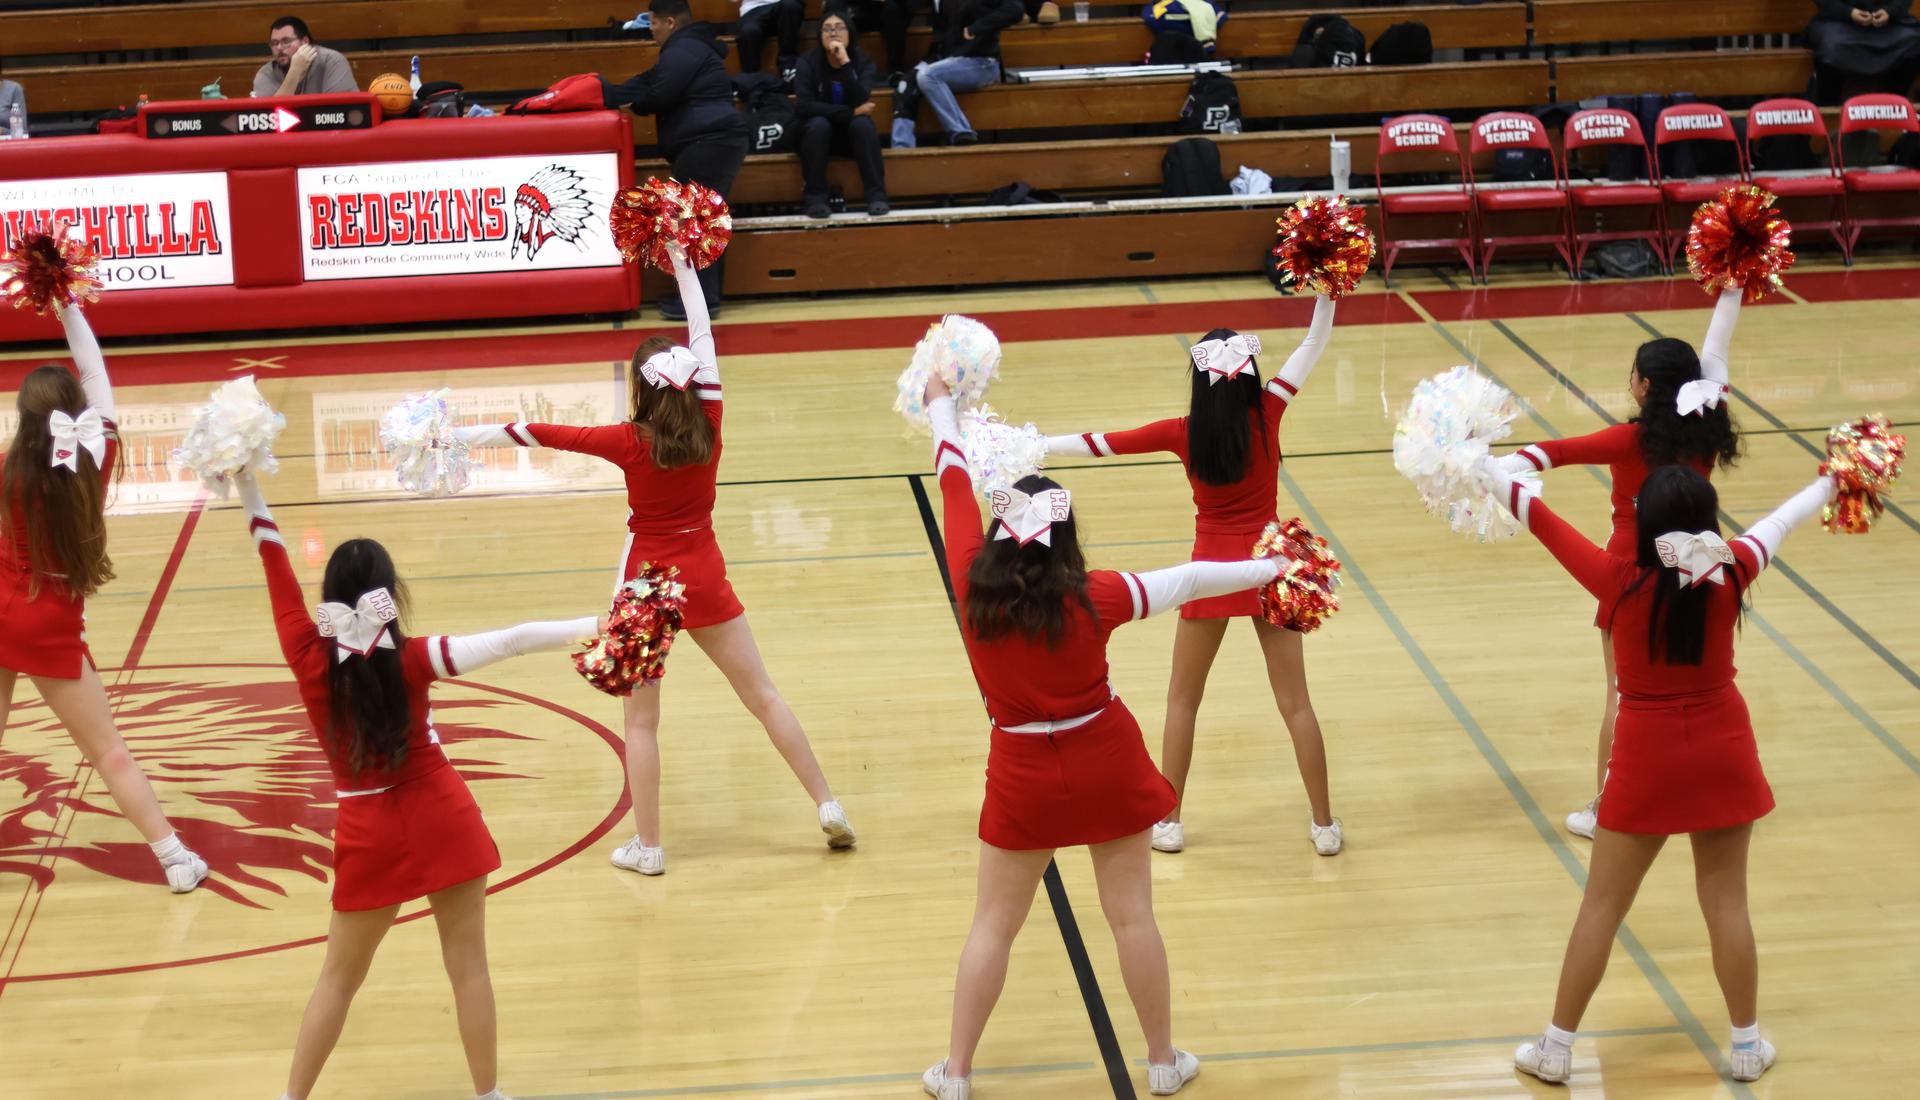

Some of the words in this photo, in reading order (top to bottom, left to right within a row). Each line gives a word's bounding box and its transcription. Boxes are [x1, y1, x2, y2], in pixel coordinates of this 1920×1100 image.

[1203, 104, 1230, 130] P
[1755, 109, 1815, 126] CHOWCHILLA
[1847, 104, 1908, 121] CHOWCHILLA
[172, 119, 202, 132] BONUS
[238, 112, 278, 131] POSS
[315, 113, 345, 125] BONUS
[1388, 121, 1446, 139] OFFICIAL
[1478, 118, 1536, 137] OFFICIAL
[1573, 114, 1631, 133] OFFICIAL
[1664, 114, 1724, 131] CHOWCHILLA
[756, 123, 783, 149] P
[1395, 134, 1440, 147] SCORER
[1486, 131, 1530, 144] SCORER
[1581, 127, 1625, 140] SCORER
[322, 173, 360, 185] FCA
[307, 186, 509, 249] REDSKINS
[311, 256, 361, 267] Redskin
[364, 254, 397, 265] Pride
[400, 251, 471, 264] Community
[474, 249, 506, 260] Wide
[95, 264, 176, 282] HOOL
[1050, 491, 1069, 521] HS
[369, 591, 398, 622] HS
